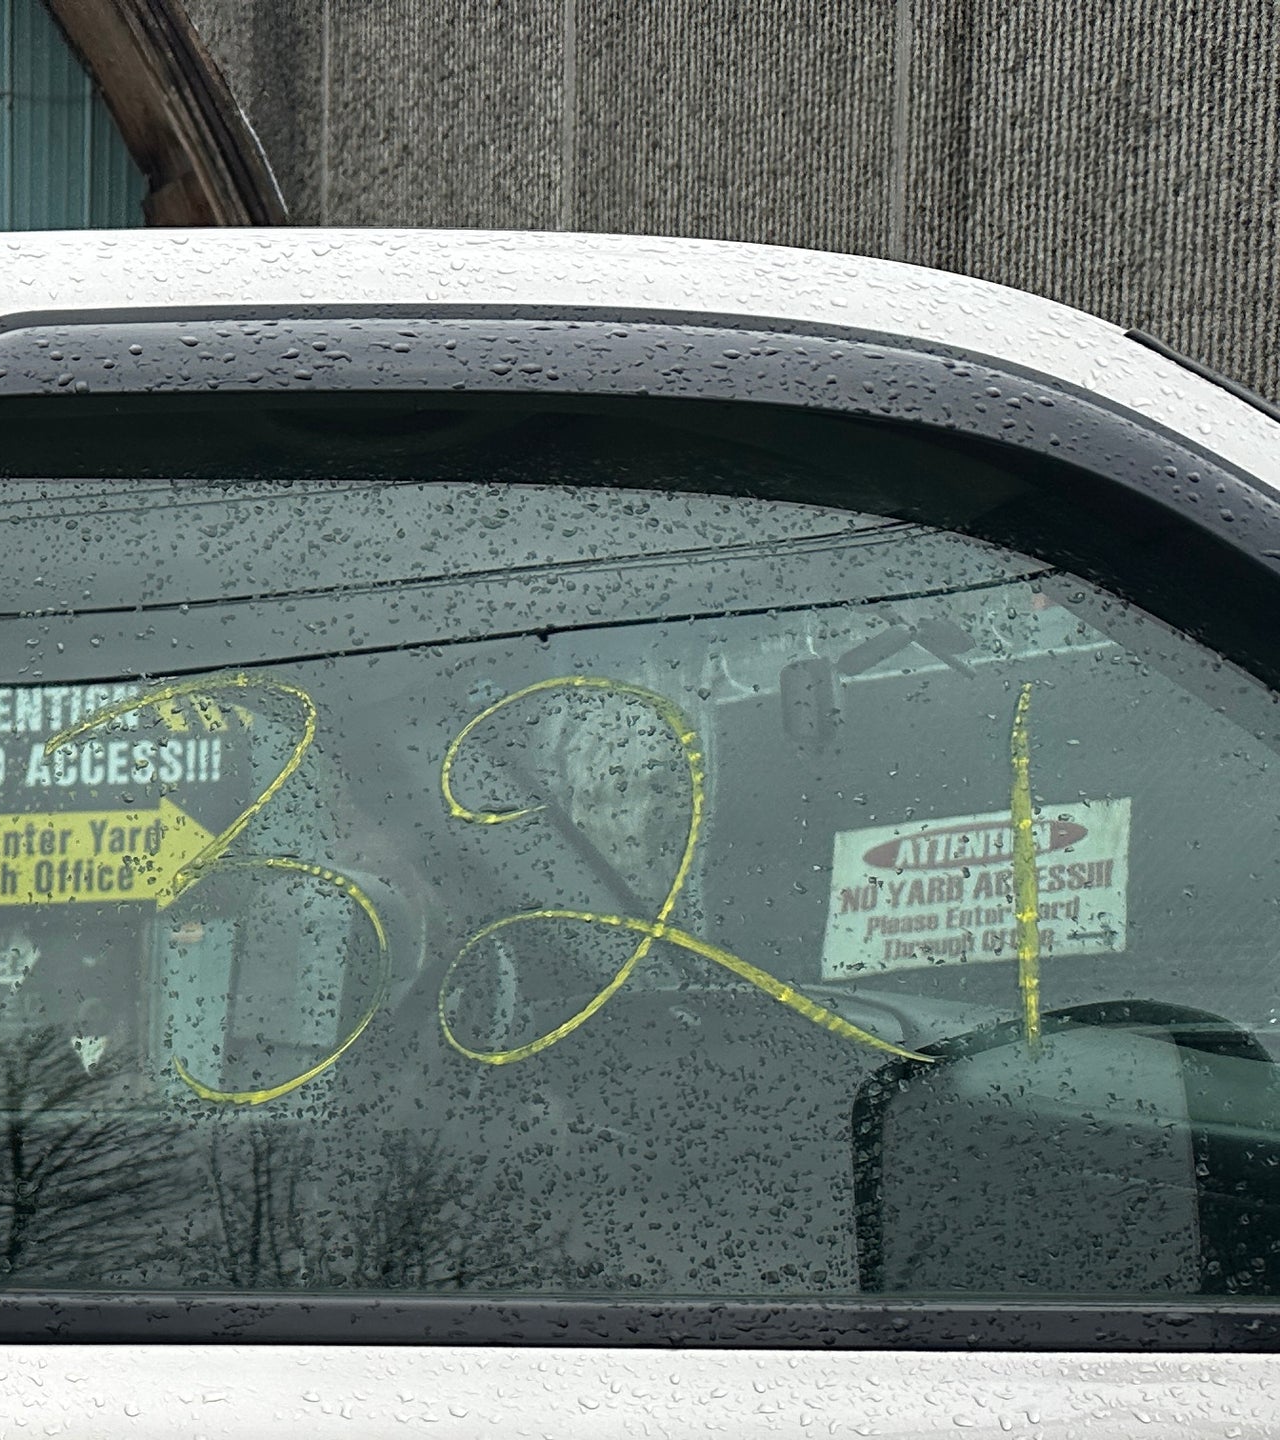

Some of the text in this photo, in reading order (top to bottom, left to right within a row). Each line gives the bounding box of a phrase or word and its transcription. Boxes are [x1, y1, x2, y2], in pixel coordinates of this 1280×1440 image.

[25, 738, 222, 788] ACCESS!!!
[88, 817, 163, 856] Yard
[895, 826, 1052, 867] ATTENTIN
[34, 858, 135, 894] Office
[841, 859, 1115, 915] NO YARD ACESS!!!
